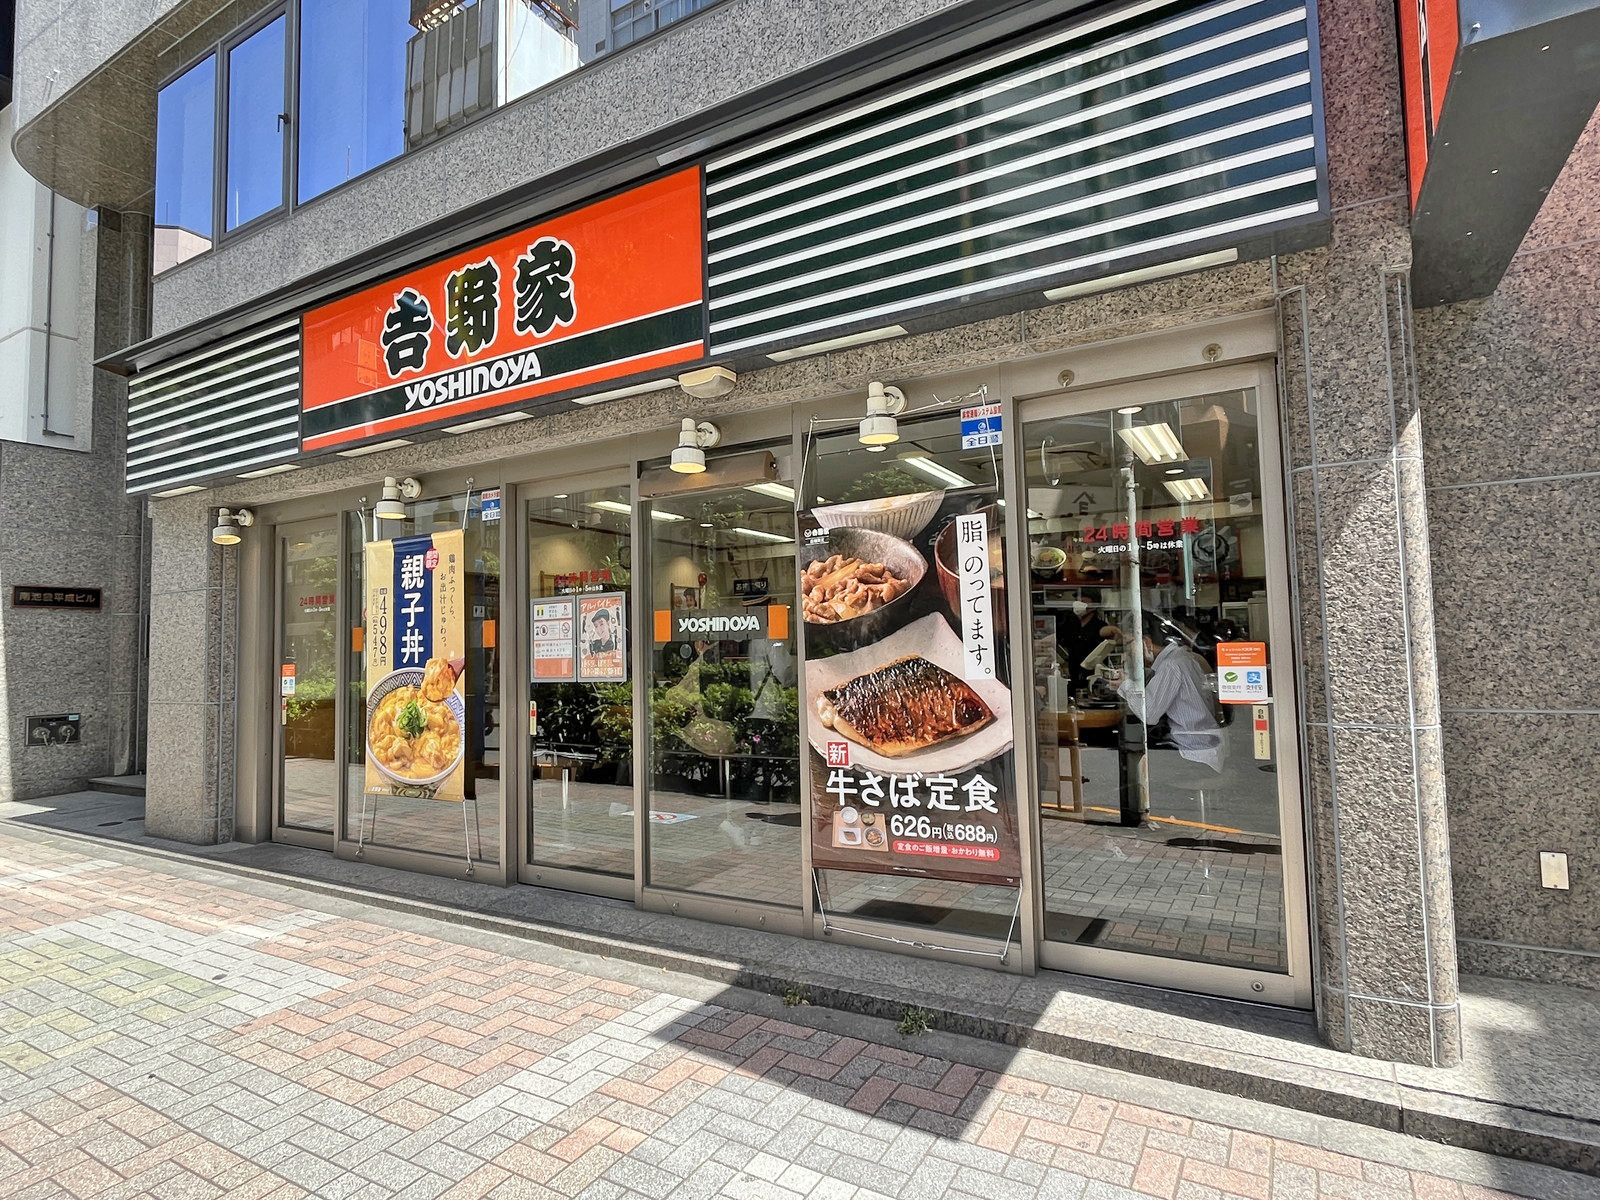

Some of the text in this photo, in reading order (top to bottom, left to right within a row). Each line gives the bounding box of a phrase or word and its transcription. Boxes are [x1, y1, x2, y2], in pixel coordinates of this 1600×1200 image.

[381, 237, 576, 378] 吉野家
[405, 352, 541, 410] YOSHINOYA
[1083, 516, 1200, 543] 24時間営業
[400, 554, 424, 664] 親子丼
[961, 520, 991, 675] 脂、のってます。
[678, 615, 760, 632] YOSHINOYA
[829, 743, 847, 765] 新
[826, 769, 998, 814] 牛さば定食
